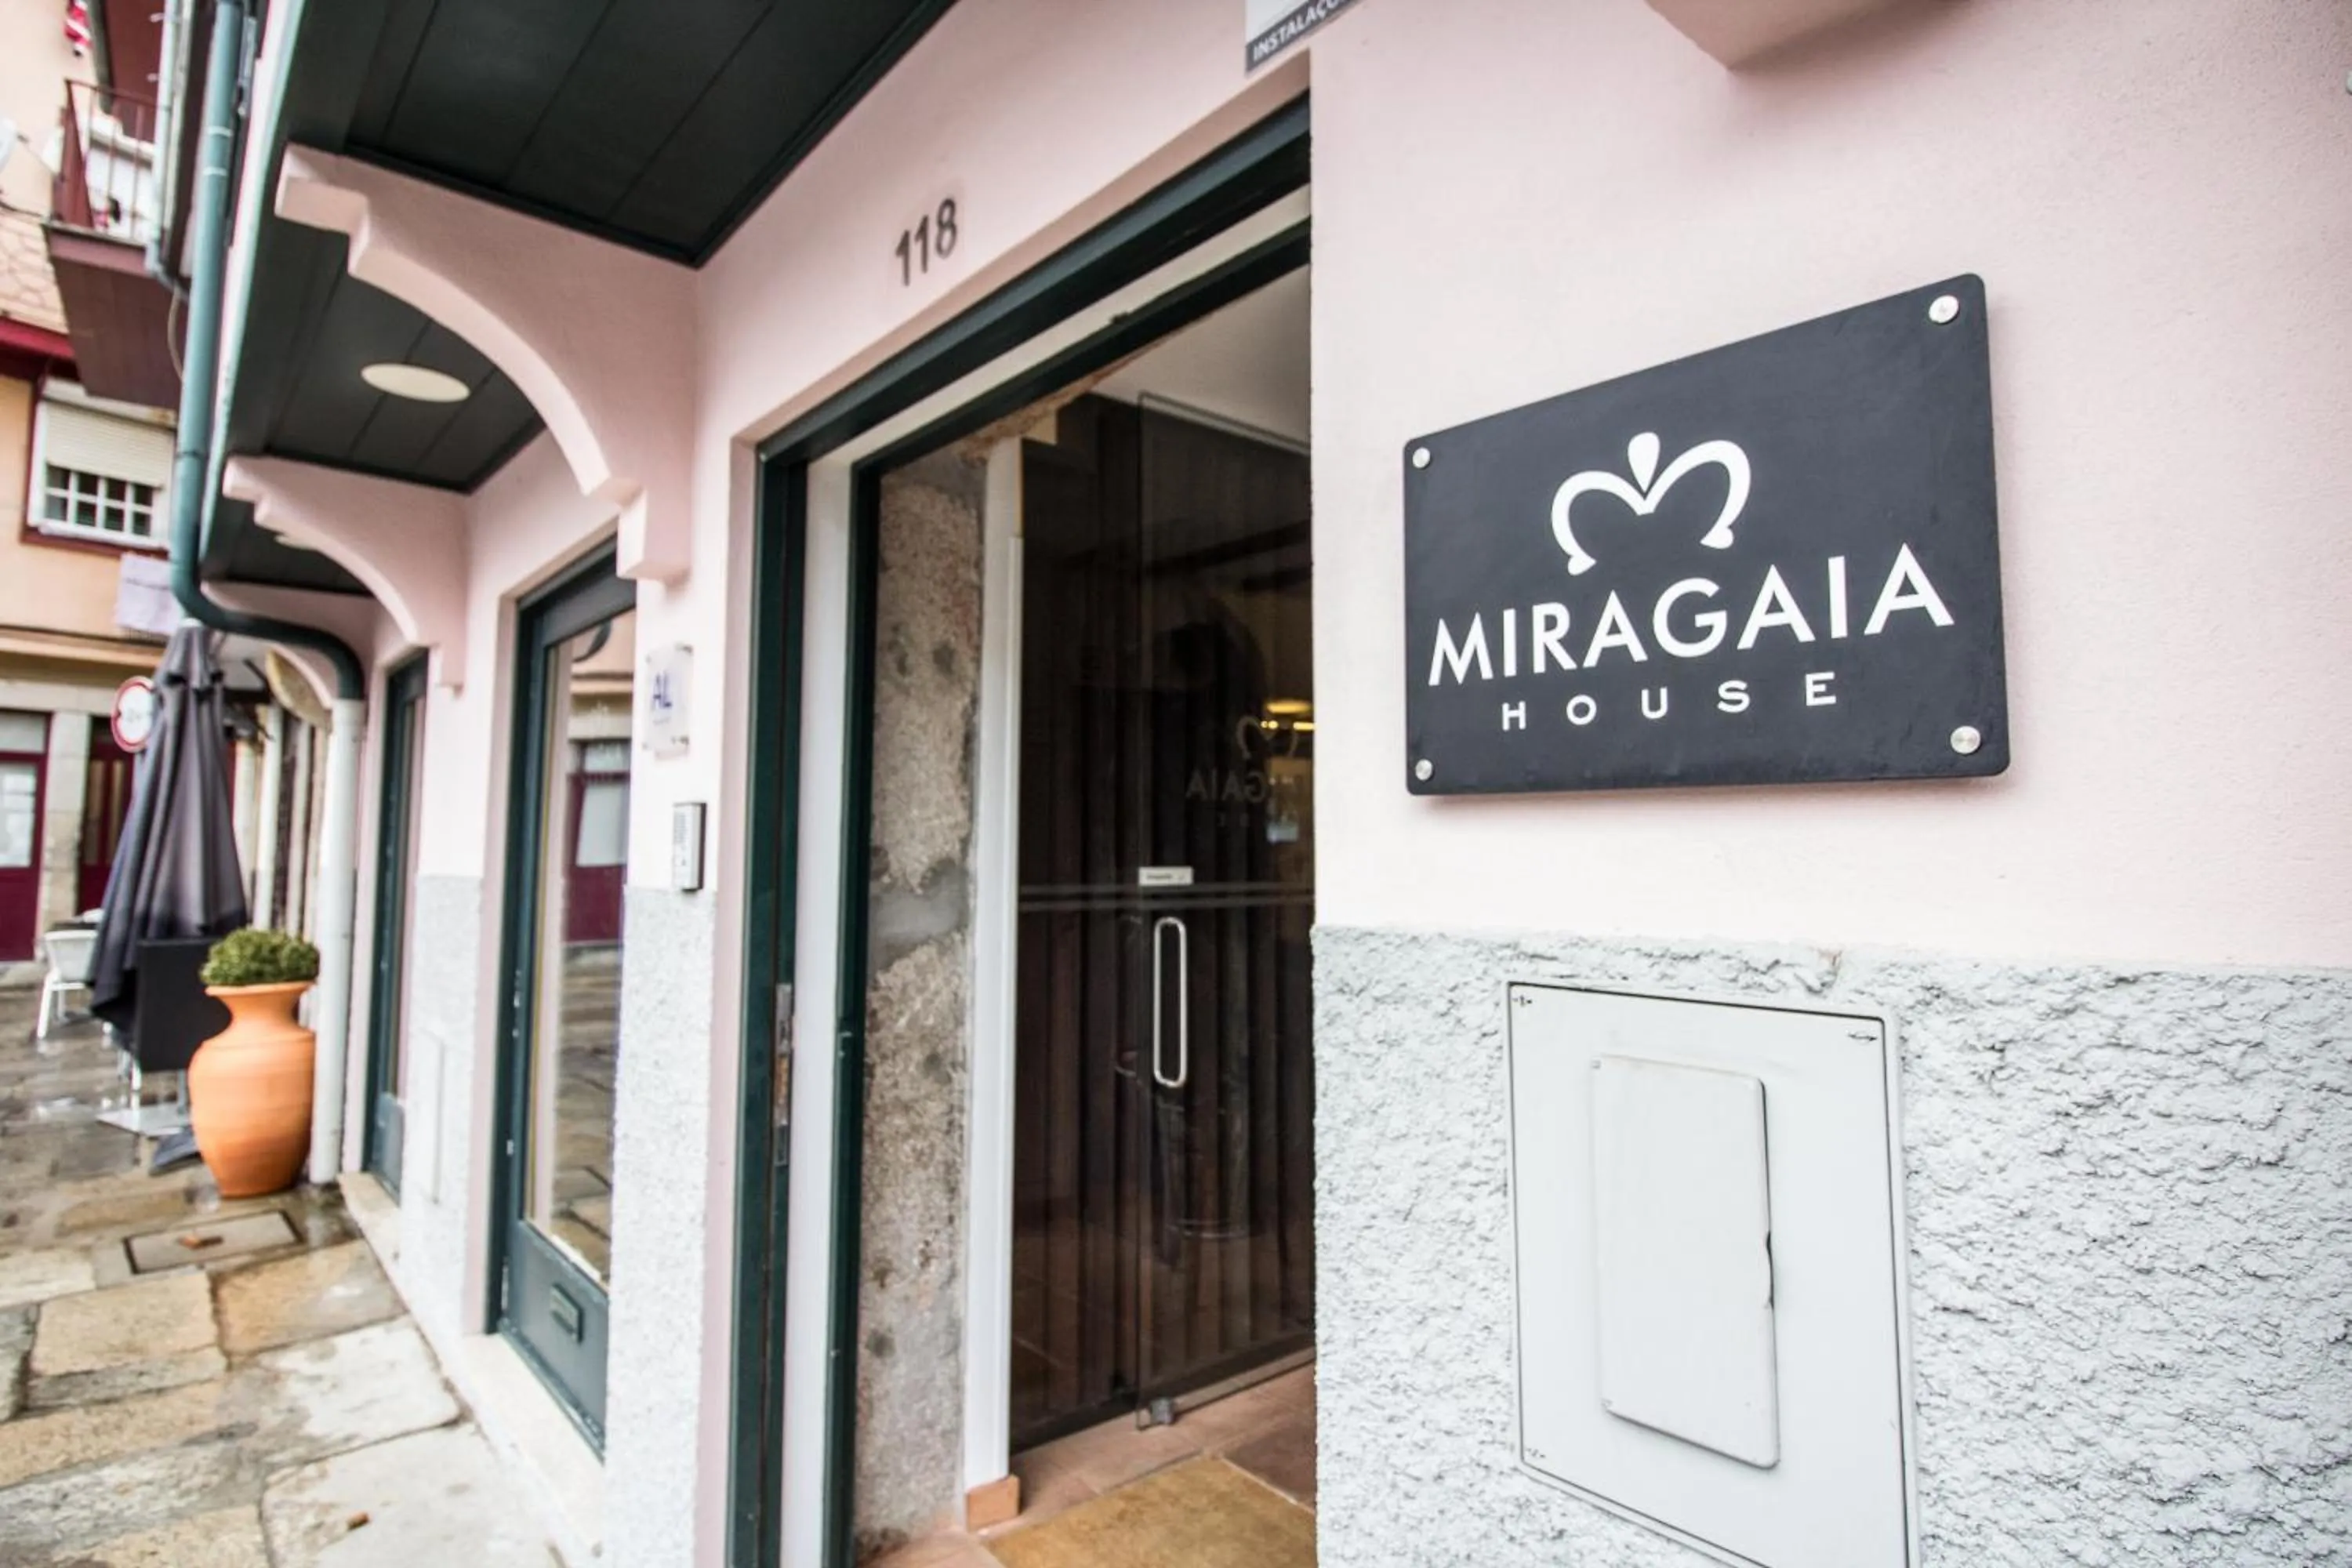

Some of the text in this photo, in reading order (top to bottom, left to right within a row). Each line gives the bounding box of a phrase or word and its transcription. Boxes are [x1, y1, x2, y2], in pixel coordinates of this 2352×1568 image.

[895, 198, 957, 287] 118
[1428, 542, 1955, 687] MIRAGAIA
[1501, 671, 1837, 731] HOUSE
